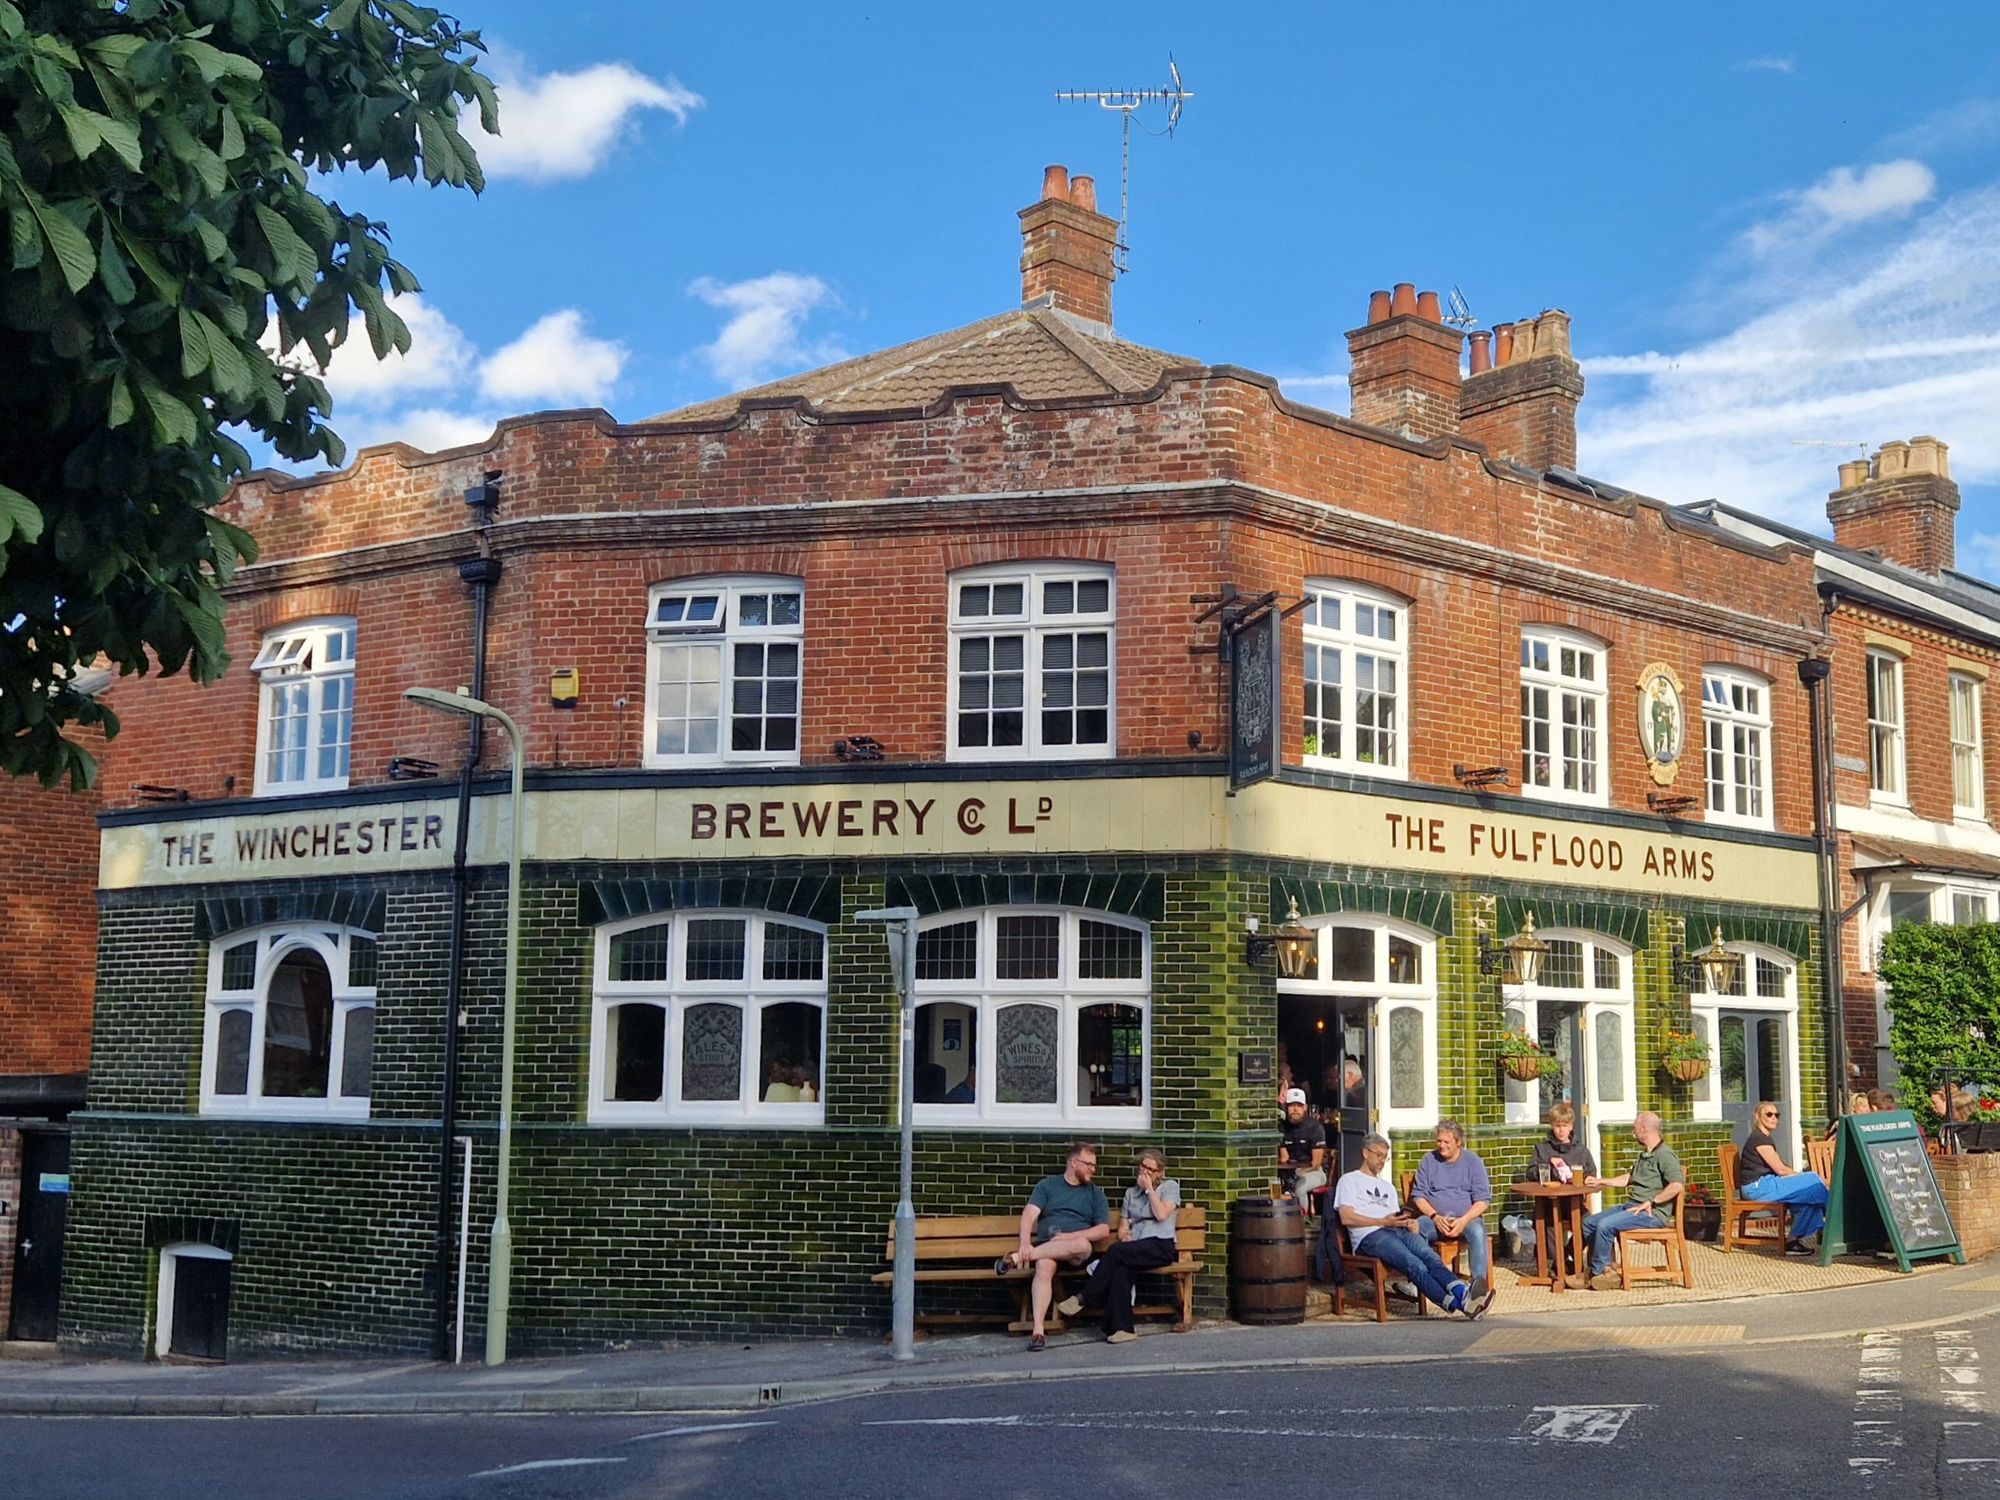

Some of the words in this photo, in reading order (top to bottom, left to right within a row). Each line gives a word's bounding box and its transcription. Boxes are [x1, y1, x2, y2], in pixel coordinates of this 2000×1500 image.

[162, 831, 214, 867] THE
[235, 815, 444, 862] WINCHESTER
[691, 799, 937, 839] BREWERY
[1385, 813, 1446, 853] THE
[1470, 823, 1623, 872] FULFLOOD
[1643, 845, 1715, 882] ARMS
[696, 1041, 727, 1055] ALES
[1007, 1042, 1041, 1056] WINES
[1013, 1055, 1044, 1064] SPIRITS
